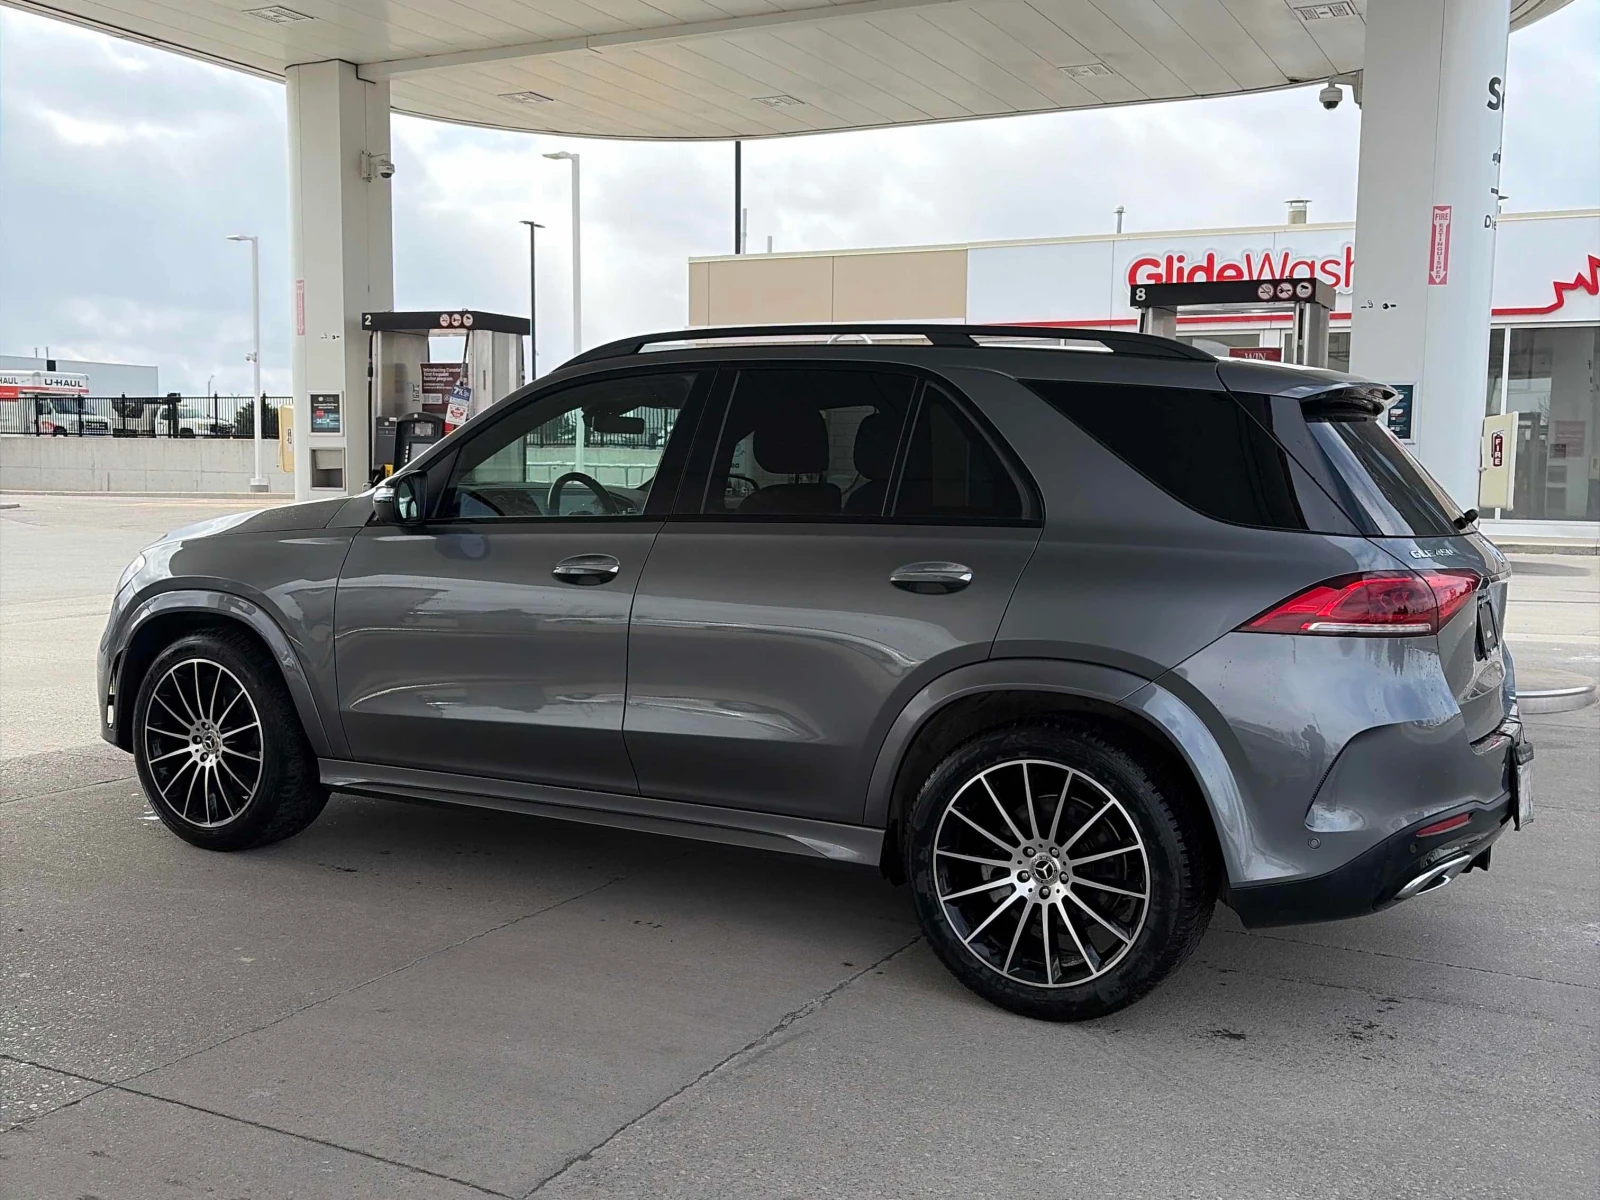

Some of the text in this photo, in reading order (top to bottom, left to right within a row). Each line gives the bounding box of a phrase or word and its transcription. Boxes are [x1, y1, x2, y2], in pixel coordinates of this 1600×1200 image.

[1487, 76, 1505, 112] S
[1435, 213, 1449, 221] FIRE
[1435, 223, 1445, 279] EXTINGUISHER
[1135, 288, 1146, 301] 8
[364, 314, 372, 326] 2
[1244, 352, 1267, 361] WIN
[1494, 438, 1502, 465] FIRE
[1409, 549, 1437, 560] GLE
